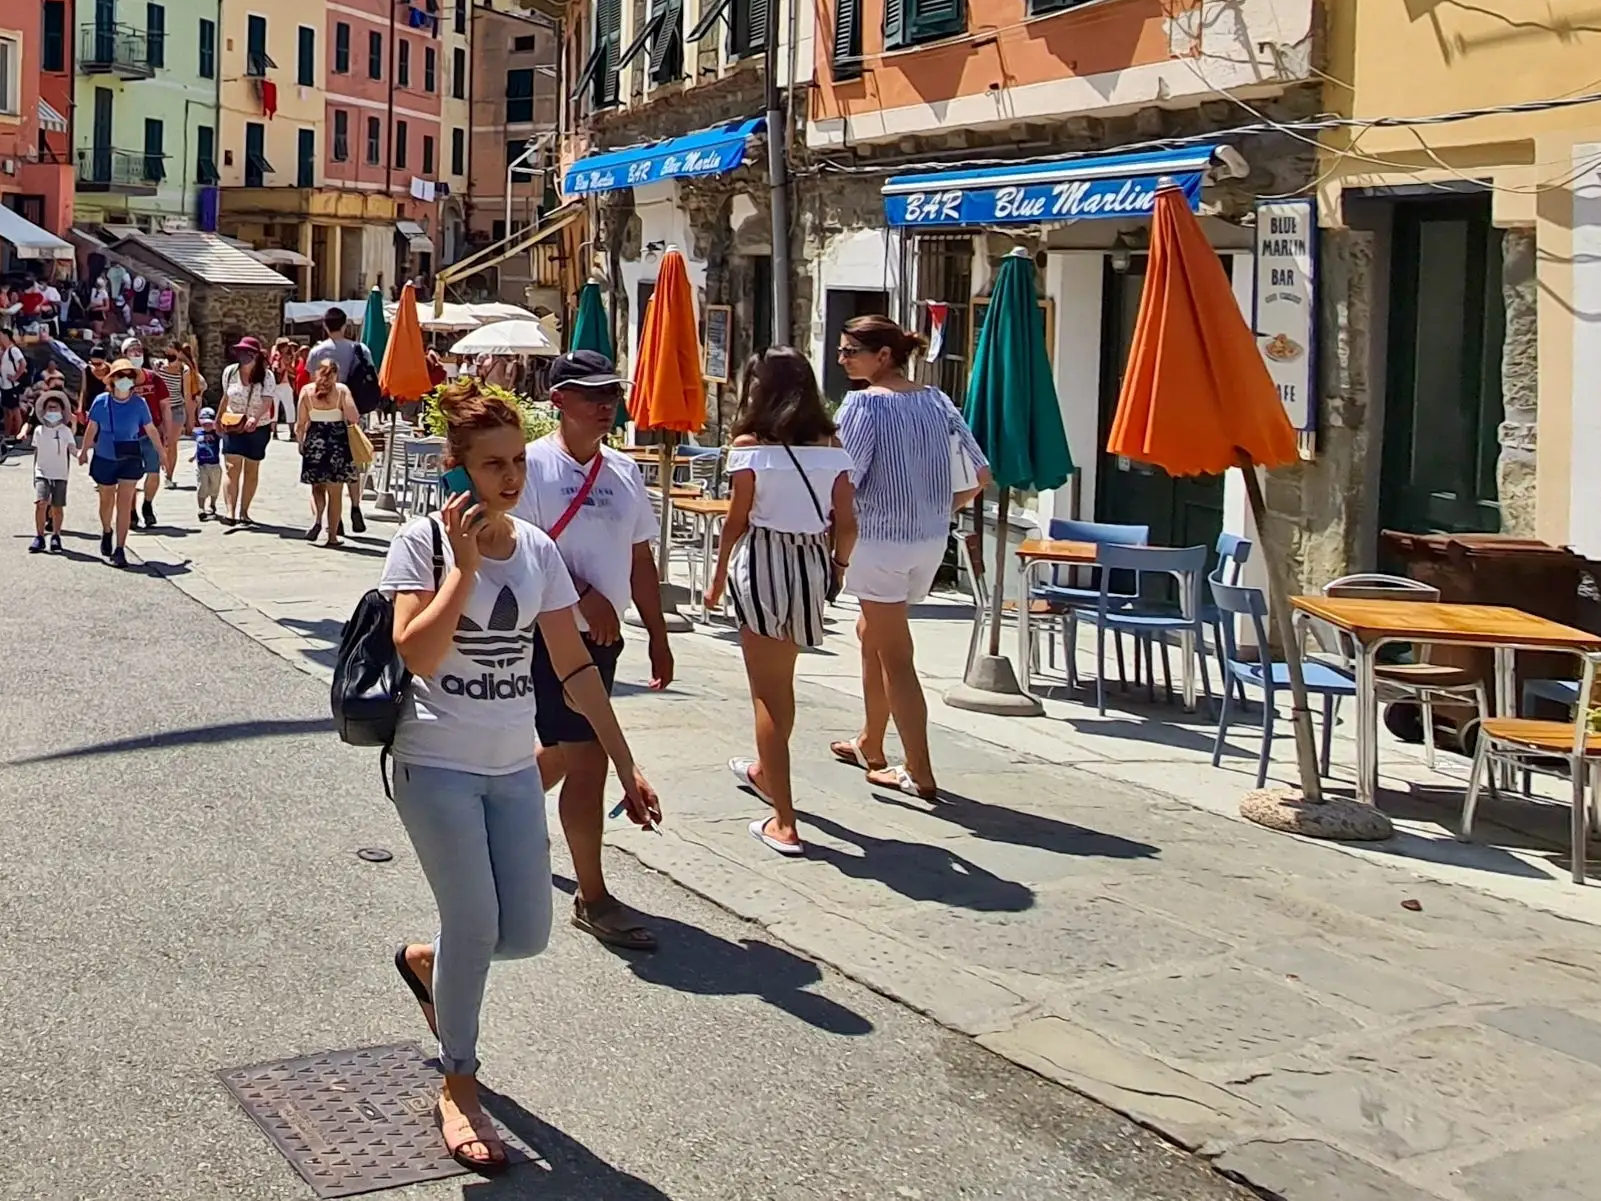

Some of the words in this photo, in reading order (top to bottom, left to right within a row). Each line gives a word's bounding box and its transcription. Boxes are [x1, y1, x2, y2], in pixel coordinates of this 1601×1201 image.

[628, 161, 653, 183] BAR
[661, 157, 682, 176] Blue
[682, 151, 722, 173] Marlin
[904, 190, 963, 221] BAR
[994, 186, 1045, 219] Blue
[1052, 179, 1155, 215] Marlin
[1270, 216, 1297, 234] BLUE
[1262, 239, 1306, 257] MARLIN
[1271, 268, 1295, 286] BAR
[441, 673, 534, 700] adidas
